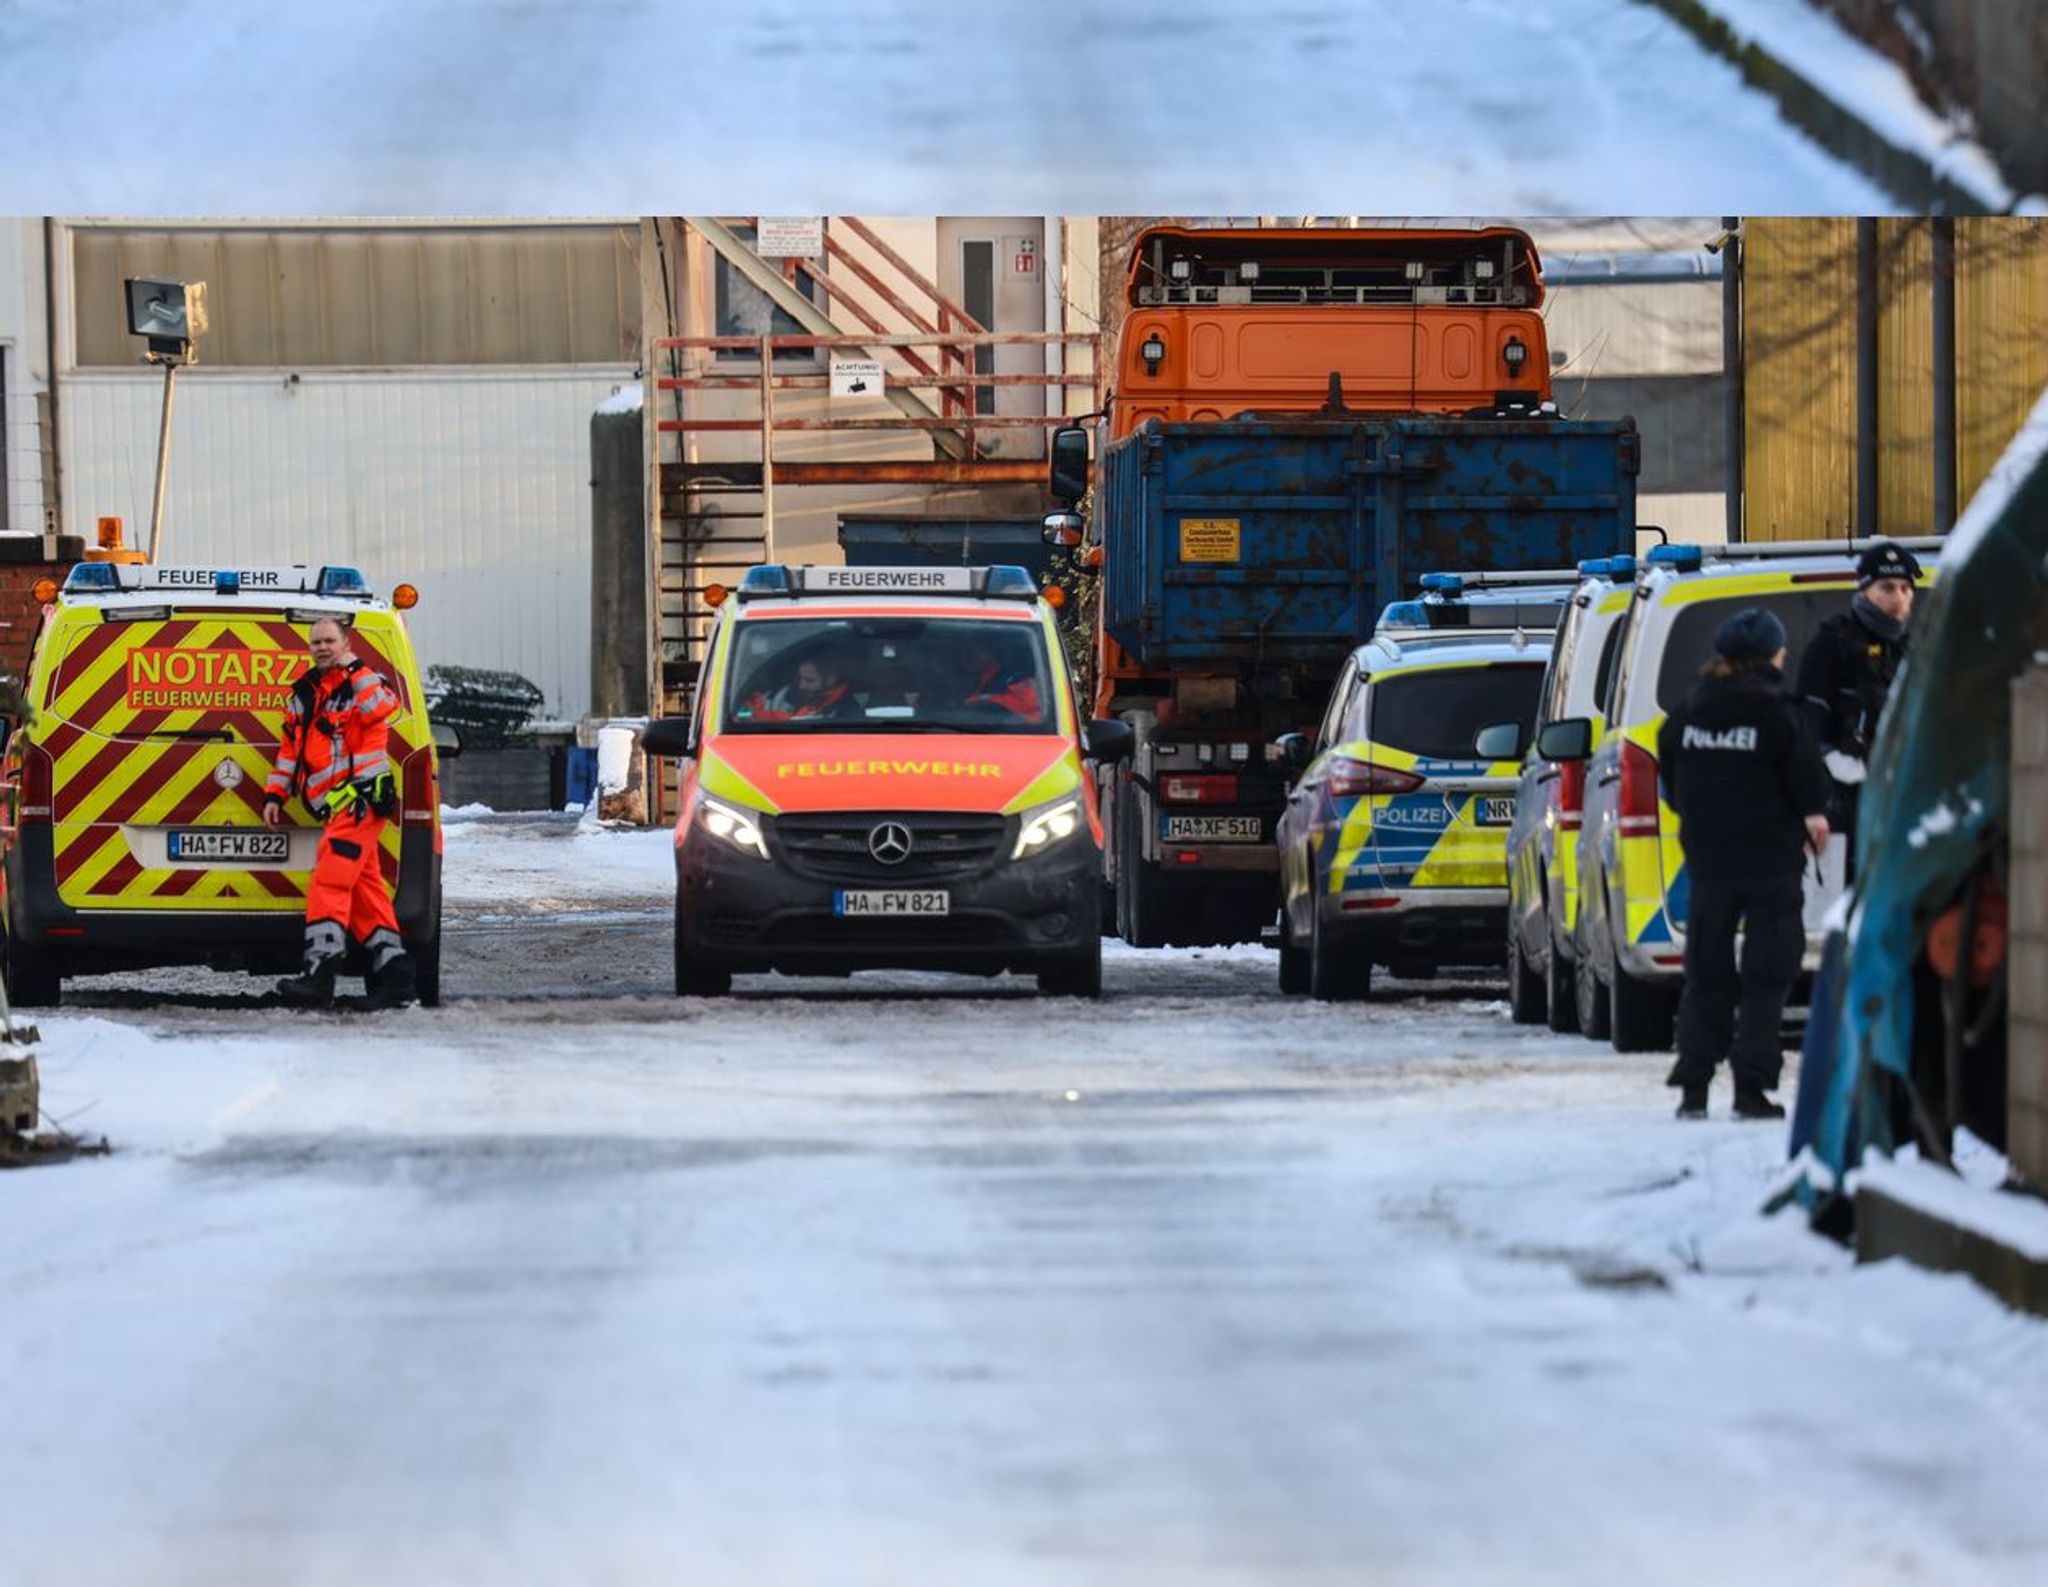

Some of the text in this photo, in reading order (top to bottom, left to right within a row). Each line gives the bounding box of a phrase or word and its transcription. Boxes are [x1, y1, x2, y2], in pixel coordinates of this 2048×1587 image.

[828, 572, 946, 586] FEUERWEHR
[132, 691, 251, 708] FEUERWEHR
[778, 760, 1002, 779] FEUERWEHR
[1376, 808, 1447, 824] POLIZEI
